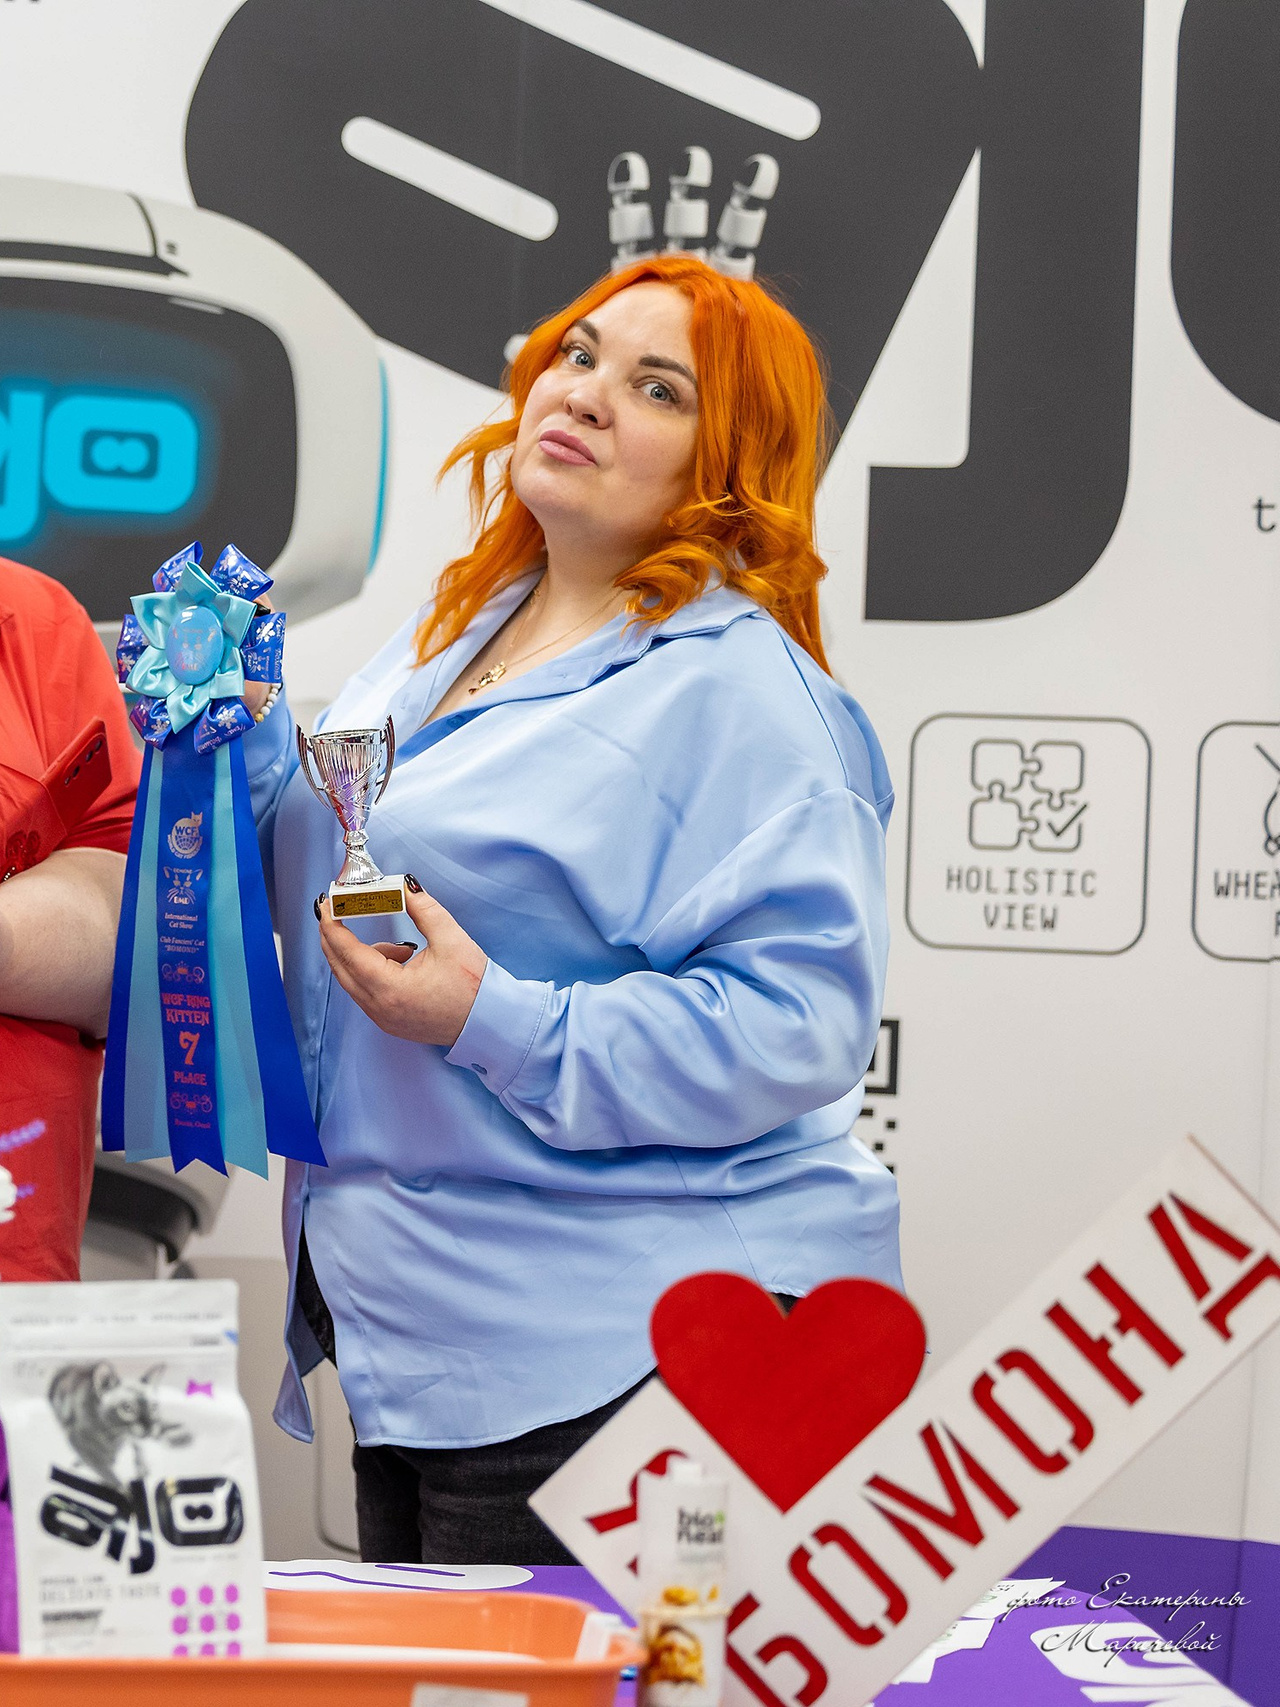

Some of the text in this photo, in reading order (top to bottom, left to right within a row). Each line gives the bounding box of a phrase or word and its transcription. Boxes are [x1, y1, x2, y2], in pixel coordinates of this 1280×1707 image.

[175, 825, 197, 836] WCF
[945, 865, 1098, 898] HOLISTIC
[165, 912, 197, 922] International
[169, 920, 194, 929] Cat Show
[982, 903, 1059, 932] VIEW
[166, 1008, 209, 1026] KITTEN
[178, 1030, 200, 1066] 7
[174, 1071, 207, 1085] PLACE
